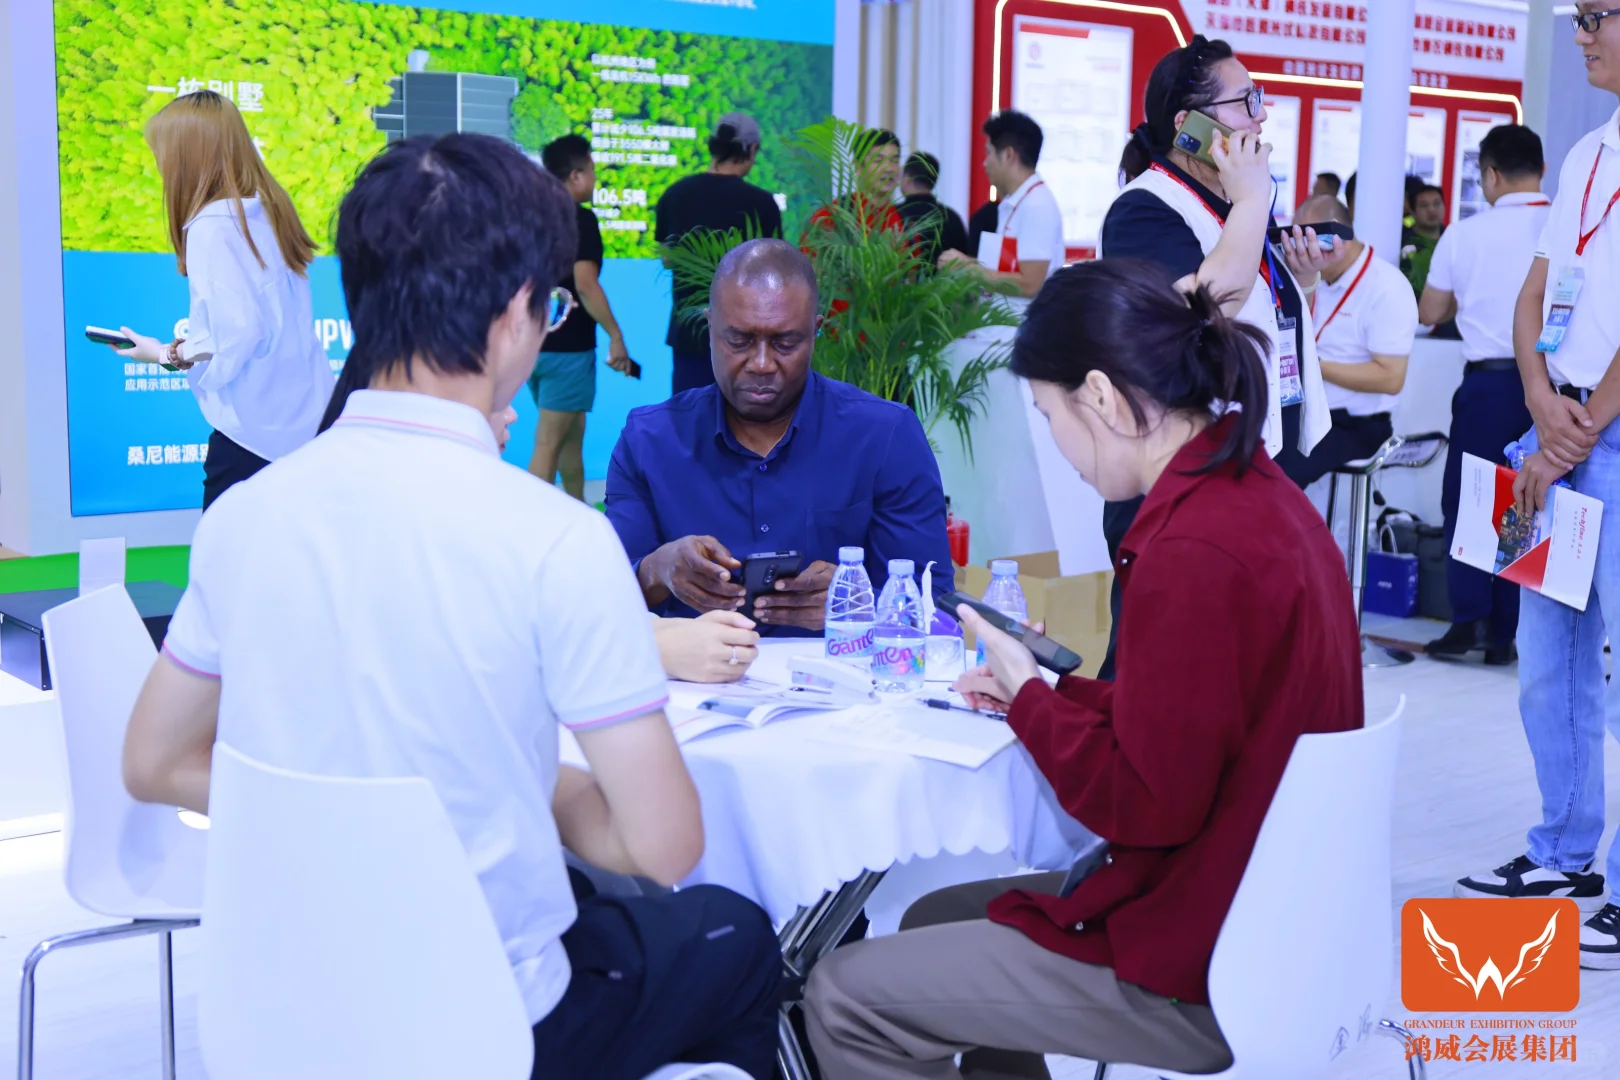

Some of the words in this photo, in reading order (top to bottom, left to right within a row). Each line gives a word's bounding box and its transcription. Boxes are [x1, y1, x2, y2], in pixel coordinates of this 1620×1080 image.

[124, 363, 188, 376] 国家首批
[828, 628, 874, 656] Gante
